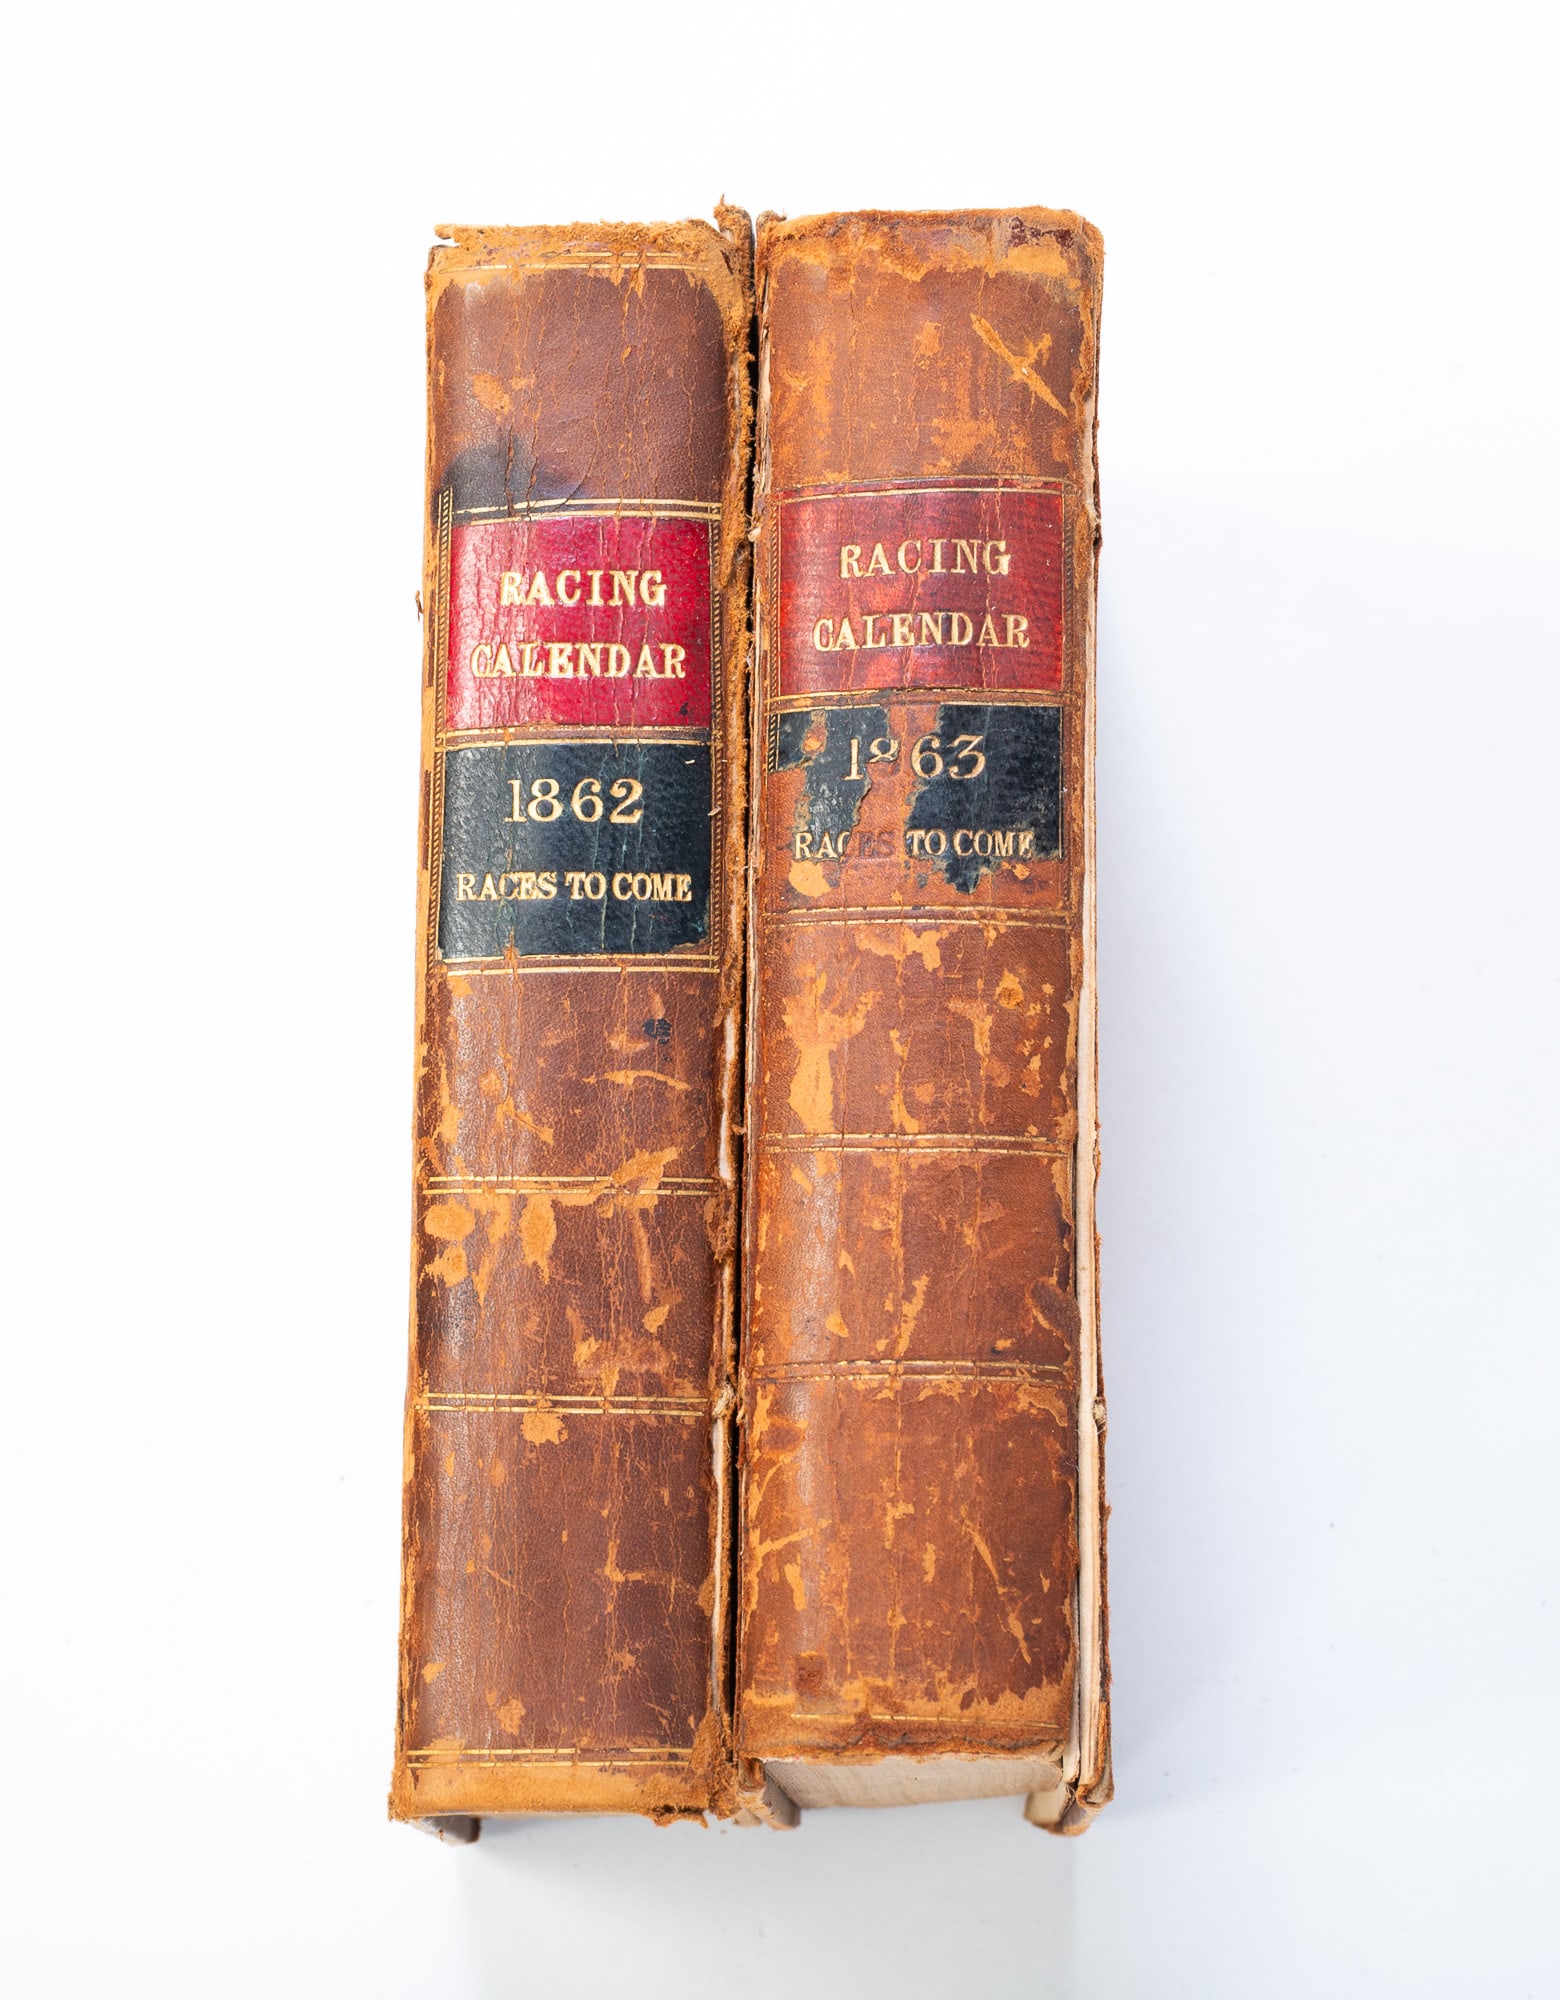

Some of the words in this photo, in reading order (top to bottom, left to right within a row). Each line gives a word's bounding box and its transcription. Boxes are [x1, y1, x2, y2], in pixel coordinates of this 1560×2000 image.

[841, 539, 1011, 578] RACING
[500, 570, 667, 606] RACING
[813, 613, 1030, 651] CALENDAR
[470, 642, 687, 680] CALENDAR
[505, 779, 643, 823] 1862
[905, 829, 946, 857] TO
[955, 829, 1036, 857] COME
[457, 873, 557, 901] RACES
[564, 872, 609, 900] TO
[612, 873, 693, 901] COME
